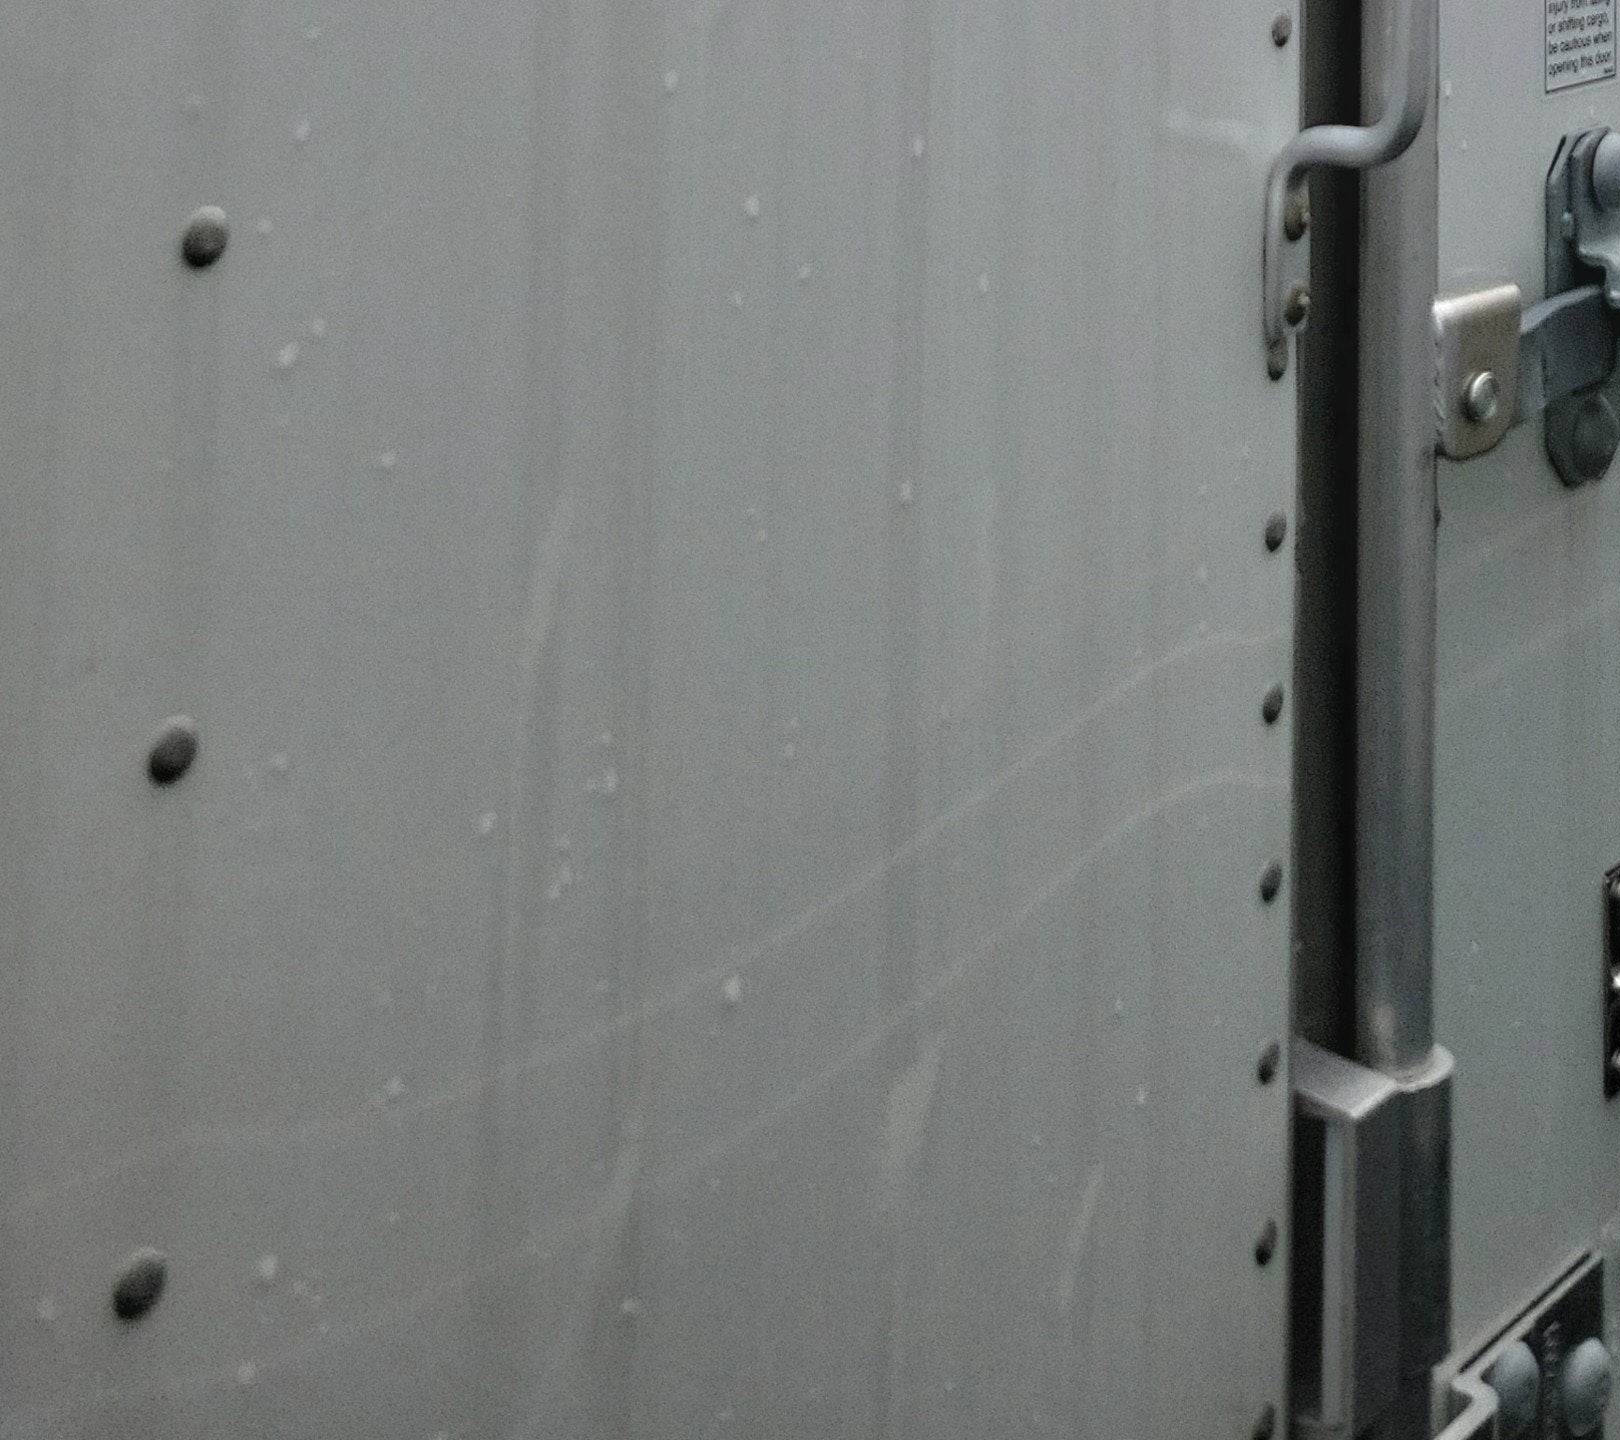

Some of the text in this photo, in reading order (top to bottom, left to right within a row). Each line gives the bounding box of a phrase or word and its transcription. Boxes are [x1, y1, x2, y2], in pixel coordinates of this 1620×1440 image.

[1558, 14, 1584, 32] shifting
[1548, 30, 1612, 54] be cautious when
[1548, 58, 1579, 78] opening
[1580, 54, 1593, 69] this
